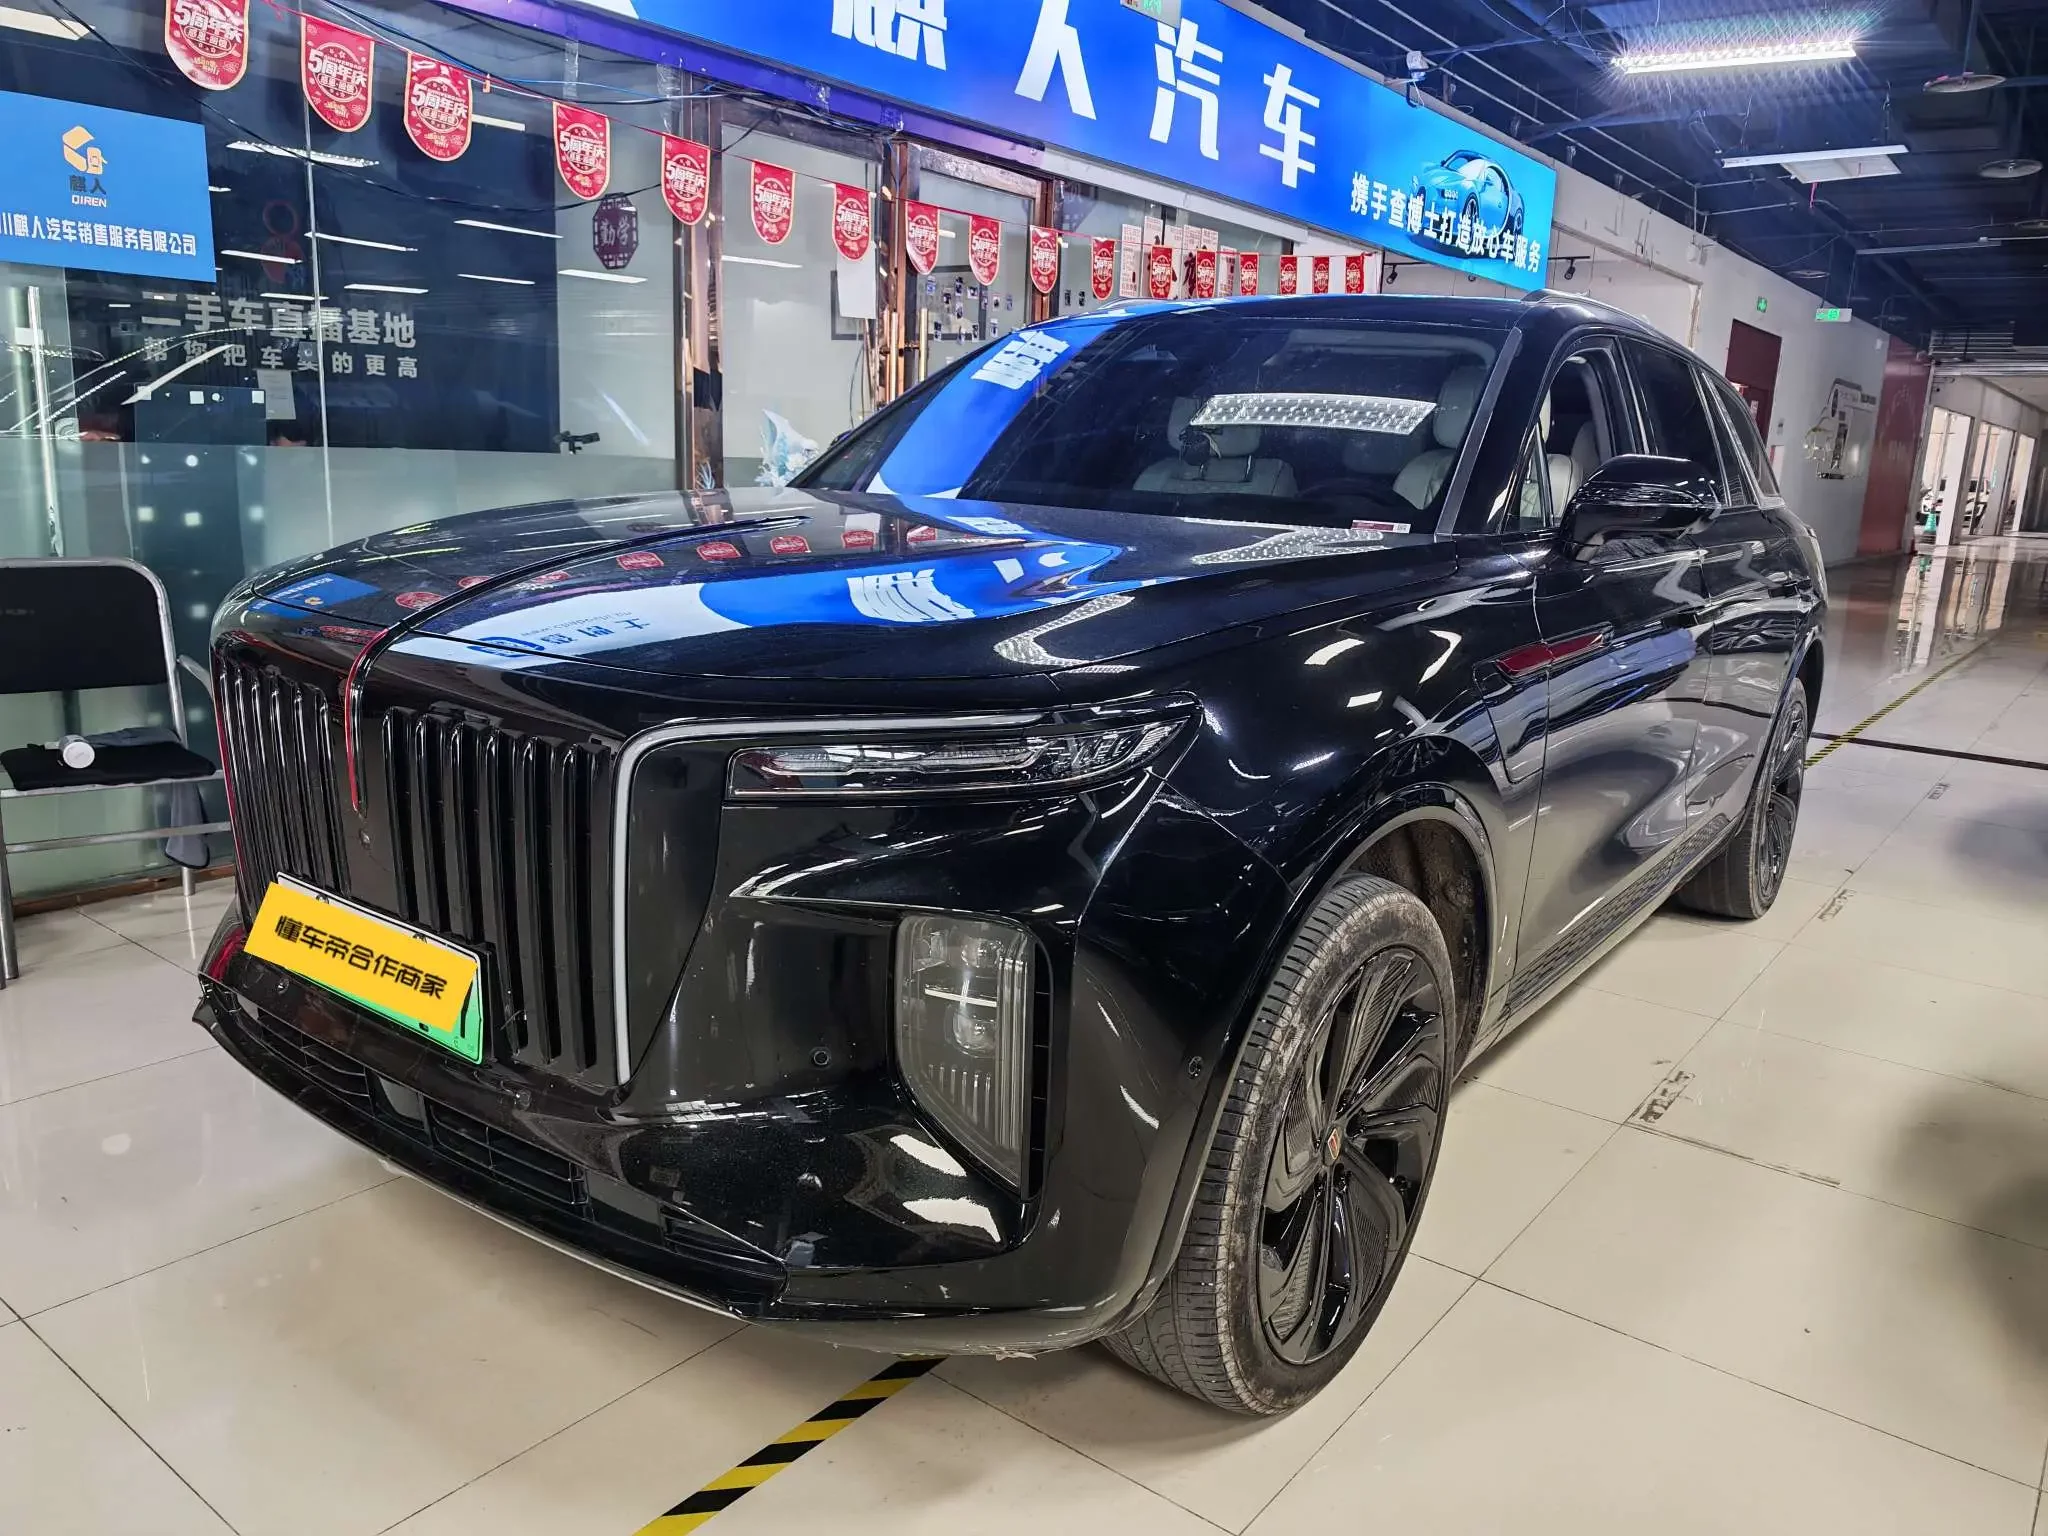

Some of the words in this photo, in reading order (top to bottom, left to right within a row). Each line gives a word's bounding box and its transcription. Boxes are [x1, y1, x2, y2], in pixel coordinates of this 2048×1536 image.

[308, 48, 368, 88] 5周年庆
[411, 82, 468, 118] 5周年庆
[71, 194, 107, 208] QIREN
[1350, 171, 1541, 273] 携手查博士打造放心车服务
[141, 291, 417, 349] 二手车直播基地
